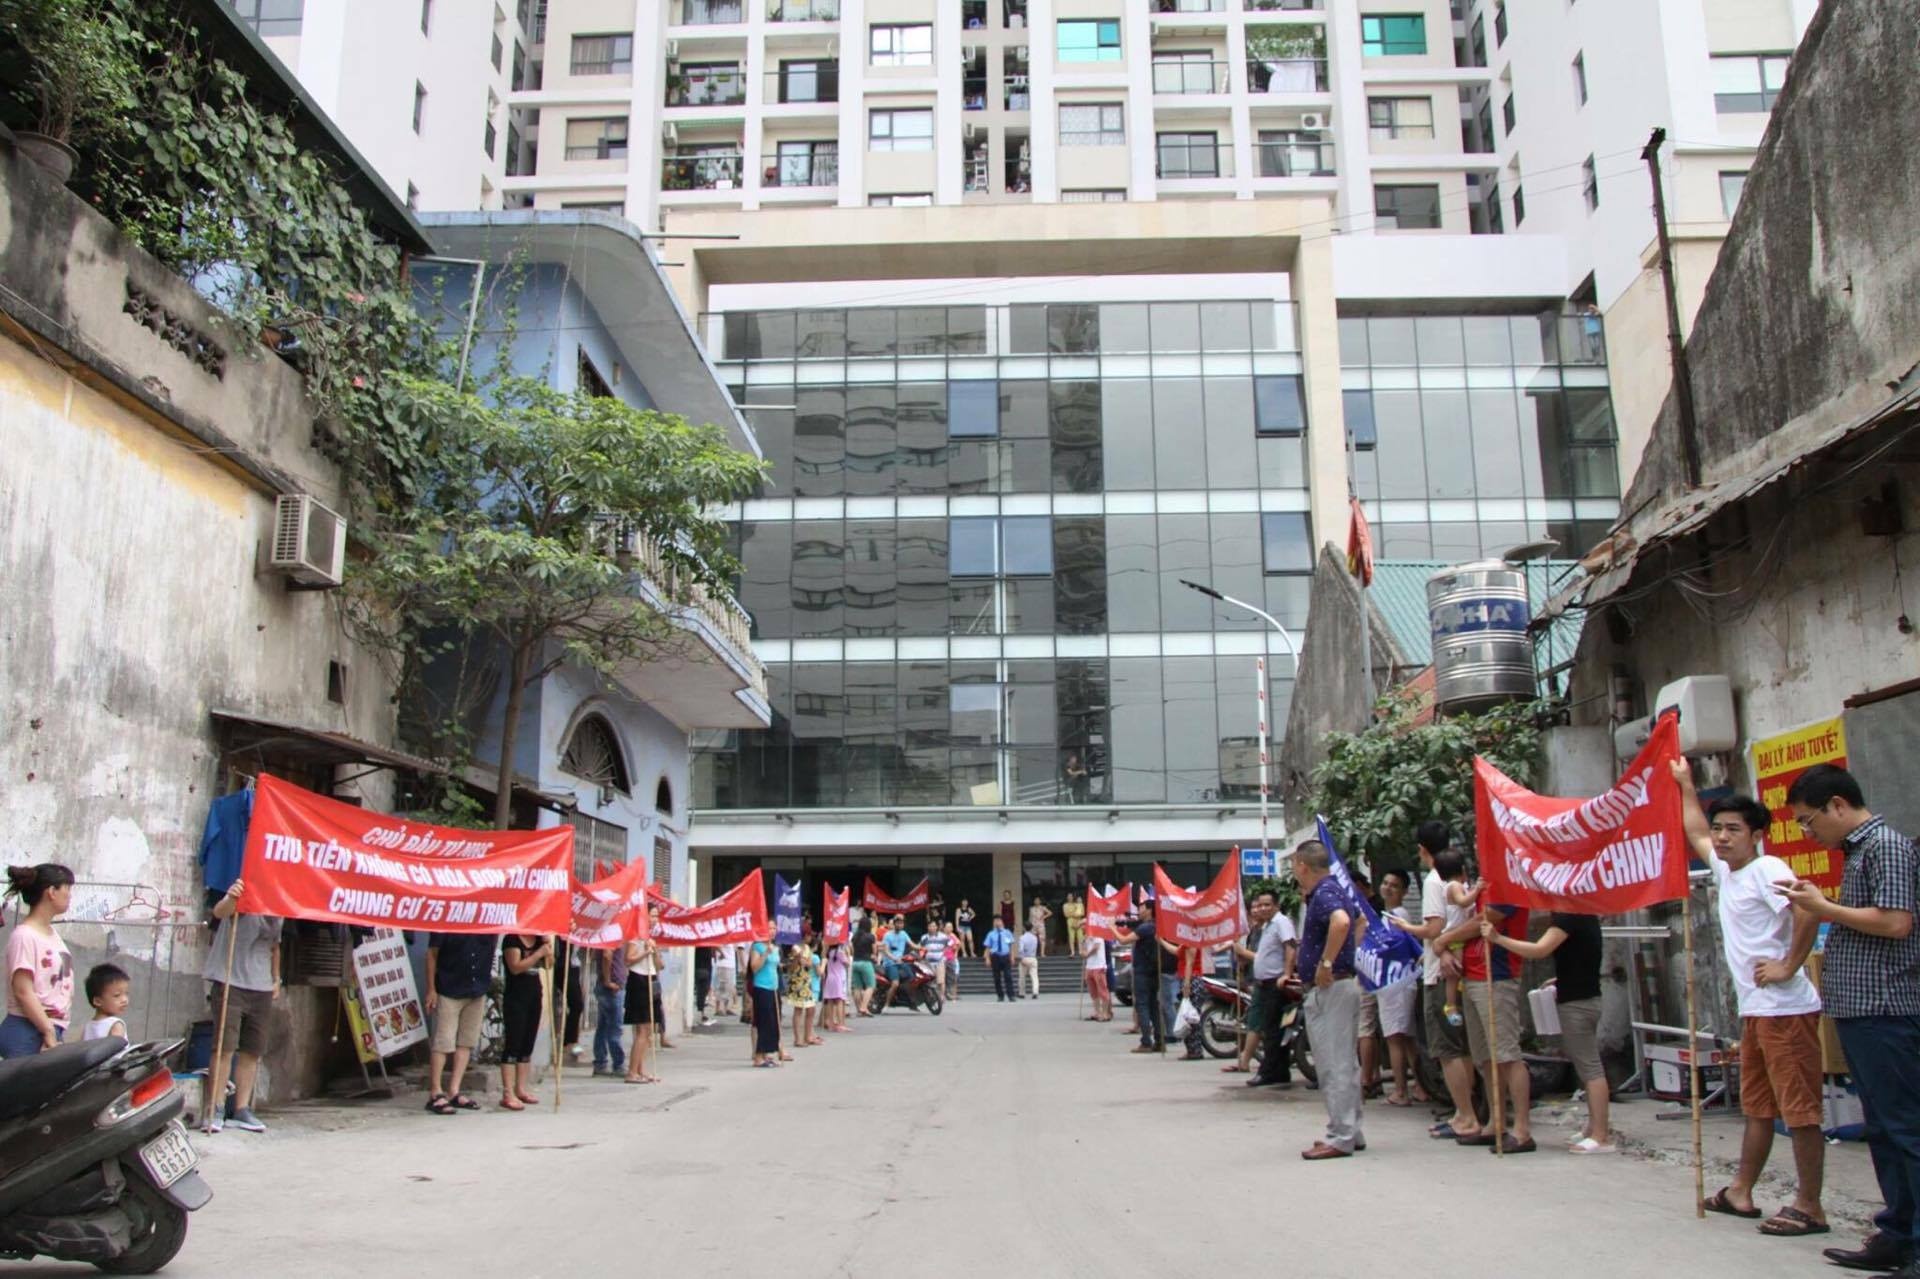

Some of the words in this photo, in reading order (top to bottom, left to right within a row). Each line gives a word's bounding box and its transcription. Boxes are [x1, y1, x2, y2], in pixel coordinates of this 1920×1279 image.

[264, 832, 303, 864] THU
[408, 863, 435, 886] CÓ
[528, 866, 569, 891] CHÍNH
[1598, 830, 1664, 889] CHÍNH
[329, 887, 395, 917] CHUNG
[396, 895, 426, 920] CƯ
[423, 899, 446, 922] 75
[446, 901, 478, 924] TAM
